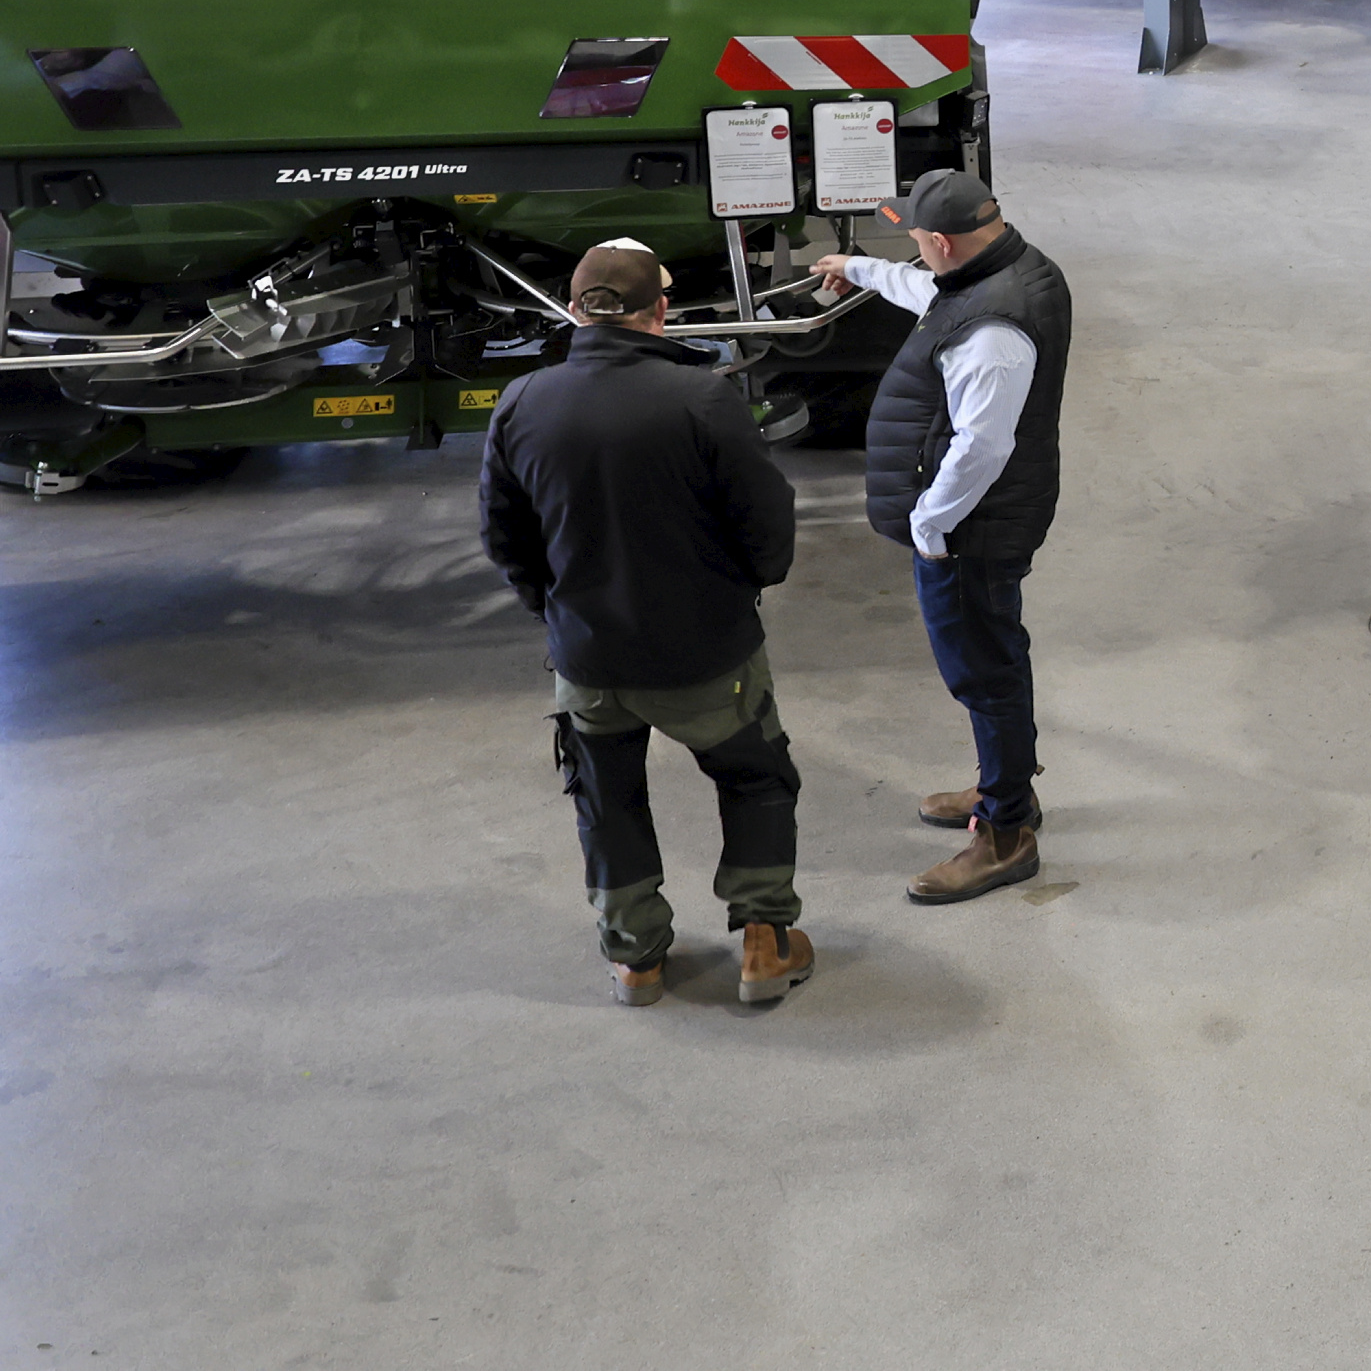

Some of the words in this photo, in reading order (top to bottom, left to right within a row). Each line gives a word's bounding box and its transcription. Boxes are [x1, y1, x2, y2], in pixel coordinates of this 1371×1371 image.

[834, 110, 871, 120] Hankkija
[728, 117, 766, 127] Hankkija
[275, 168, 353, 184] ZA-TS
[357, 165, 419, 181] 4201
[424, 163, 468, 176] Ultra
[731, 200, 792, 210] AMAZONE
